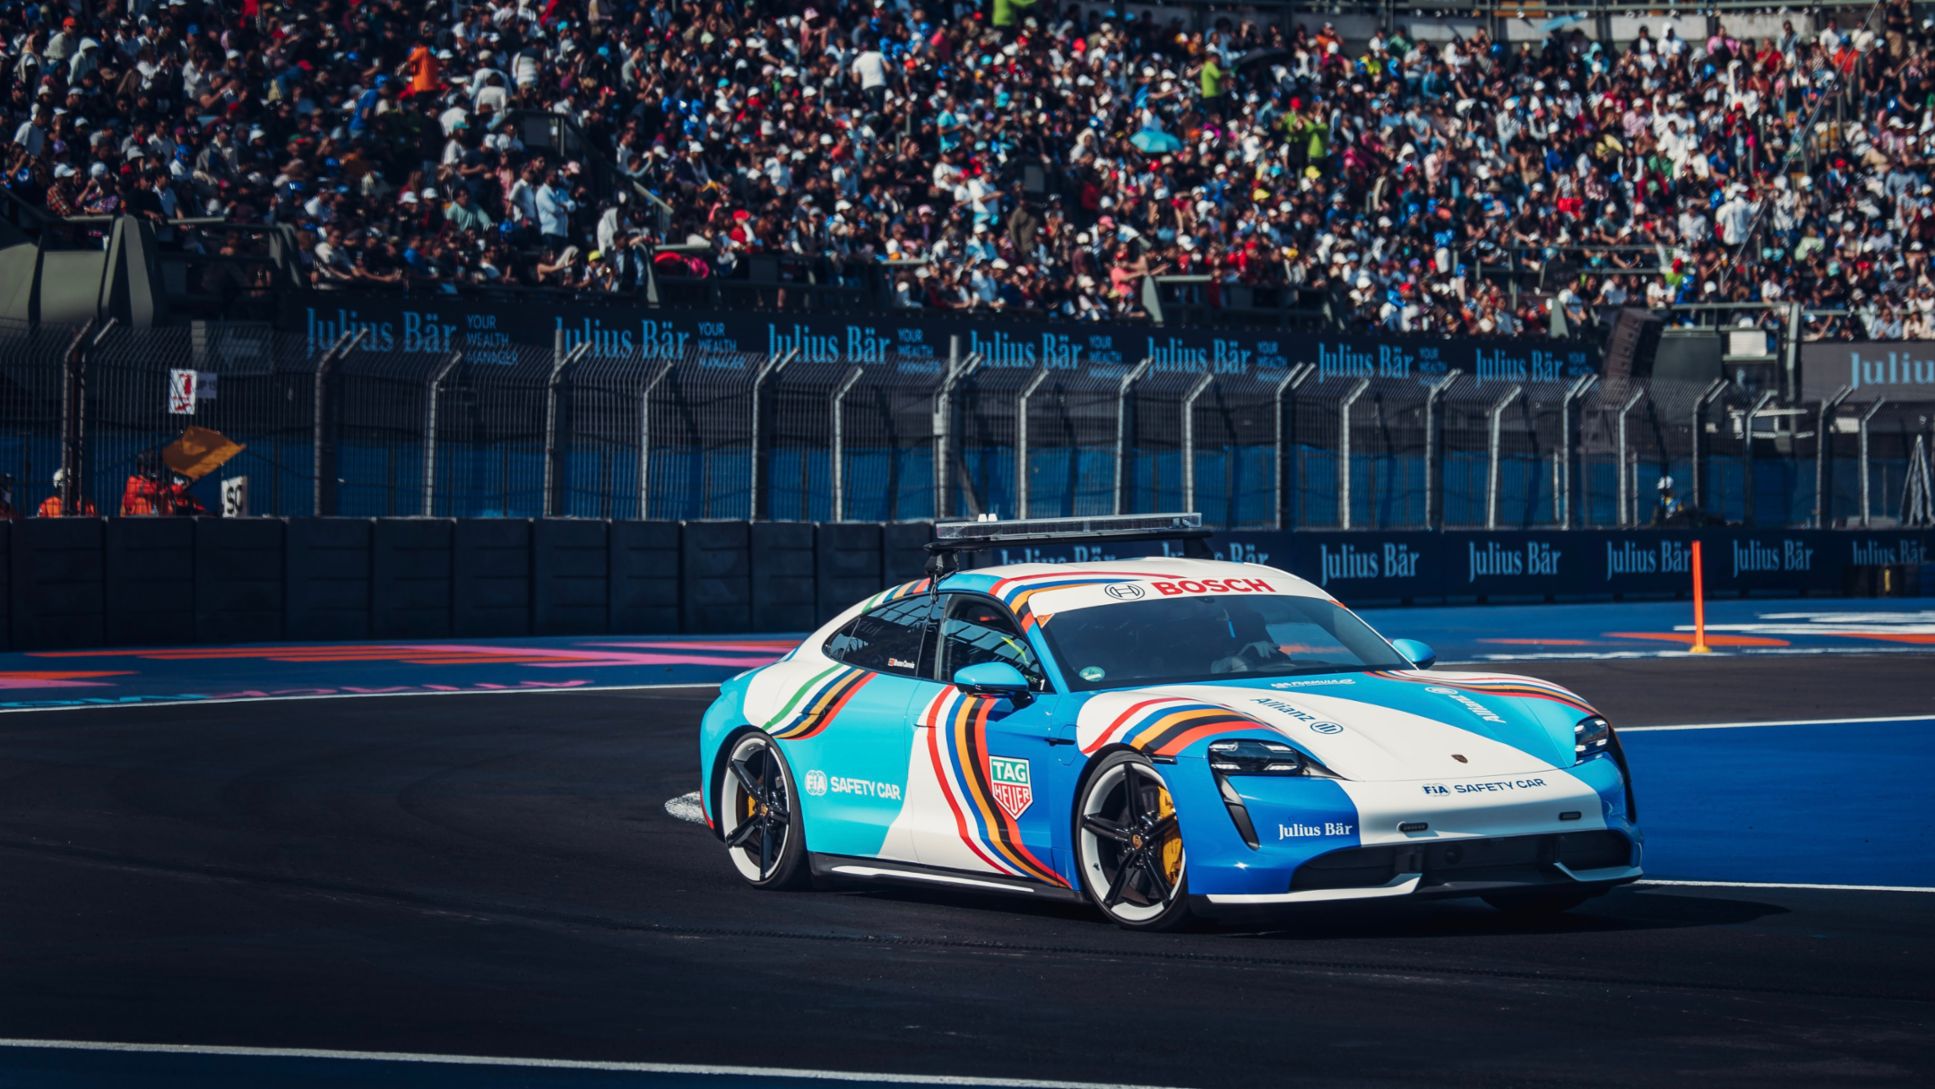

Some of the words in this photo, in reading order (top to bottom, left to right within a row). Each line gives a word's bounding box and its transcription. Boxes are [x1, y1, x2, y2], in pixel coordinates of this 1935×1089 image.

[307, 307, 394, 360] Julius
[403, 311, 457, 352] Bär
[467, 315, 497, 329] YOUR
[698, 322, 725, 336] YOUR
[898, 328, 923, 342] YOUR
[467, 332, 510, 346] WEALTH
[555, 316, 634, 358] ulius
[642, 319, 690, 360] Bär
[698, 339, 737, 353] WEALTH
[768, 323, 839, 363] Julius
[847, 325, 891, 364] Bär
[1042, 332, 1083, 369] Bär
[1148, 336, 1207, 379] Julius
[1213, 338, 1251, 374] Bär
[1319, 342, 1375, 384] Julius
[1379, 344, 1414, 378] Bär
[1476, 348, 1526, 389] Julius
[1532, 350, 1563, 383] Bär
[1851, 352, 1935, 390] Juliu
[1321, 544, 1379, 586] Julius
[1384, 543, 1419, 577] Bär
[1469, 542, 1523, 582] Julius
[1527, 541, 1562, 575] Bär
[1606, 541, 1656, 580] Julius
[1661, 541, 1692, 573] Bär
[1733, 539, 1780, 578] Julius
[1785, 539, 1814, 571] Bär
[1900, 540, 1927, 565] Bär
[1152, 579, 1276, 596] BOSCH
[1249, 698, 1316, 721] Allianz
[992, 761, 1028, 782] TAG
[1454, 781, 1514, 793] SAFETY
[1516, 778, 1546, 788] CAR
[830, 776, 875, 797] SAFETY
[877, 782, 901, 800] CAR
[994, 784, 1031, 814] HEUER
[1279, 823, 1321, 840] Julius
[1324, 822, 1353, 835] Bär
